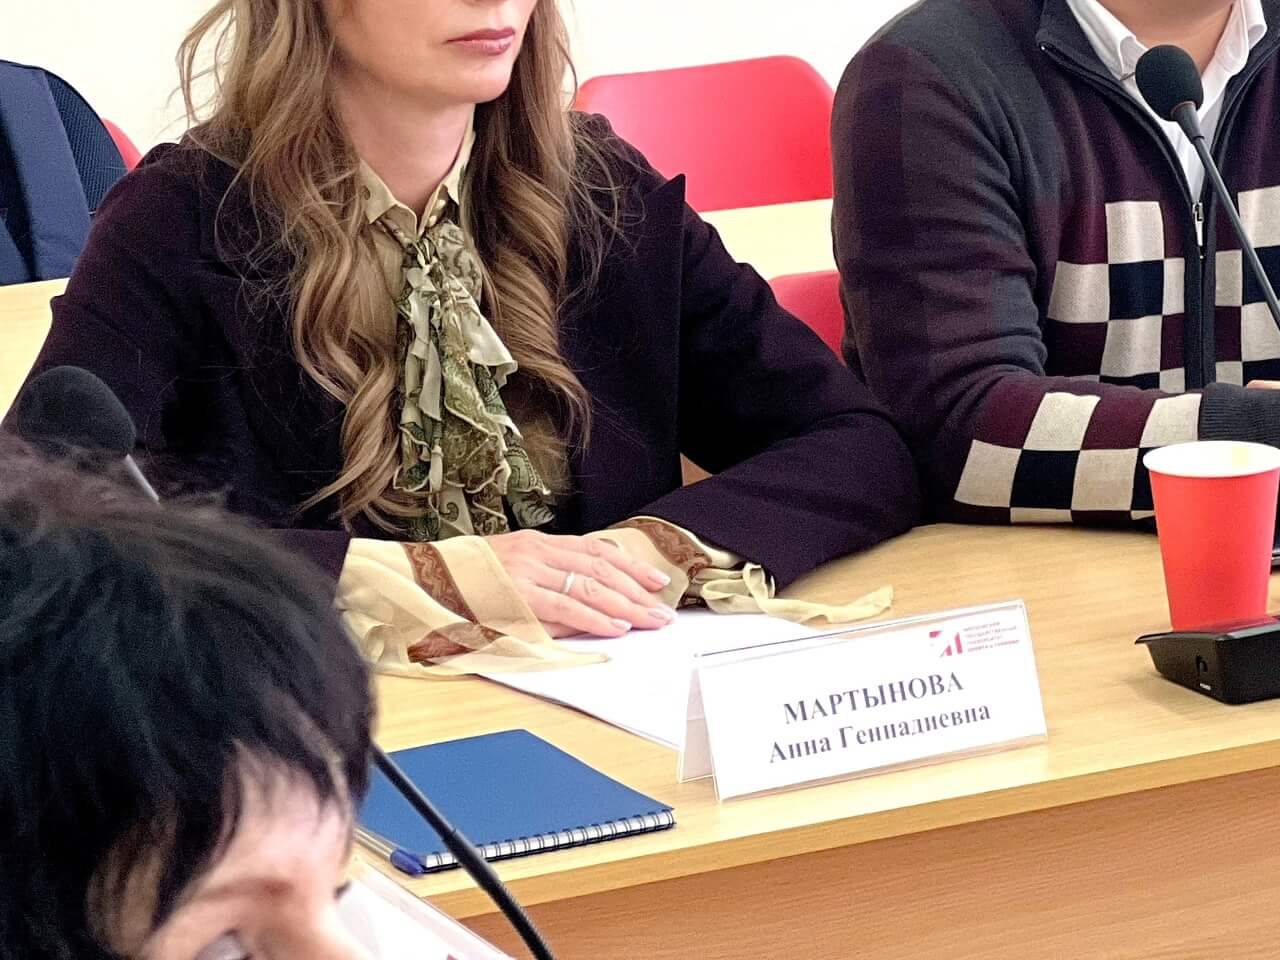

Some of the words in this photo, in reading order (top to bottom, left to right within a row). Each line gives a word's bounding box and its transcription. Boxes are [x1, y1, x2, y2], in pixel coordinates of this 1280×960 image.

[783, 671, 965, 725] МАРТЫНОВА
[768, 738, 832, 764] Анна
[839, 703, 992, 748] Геннадиевна
